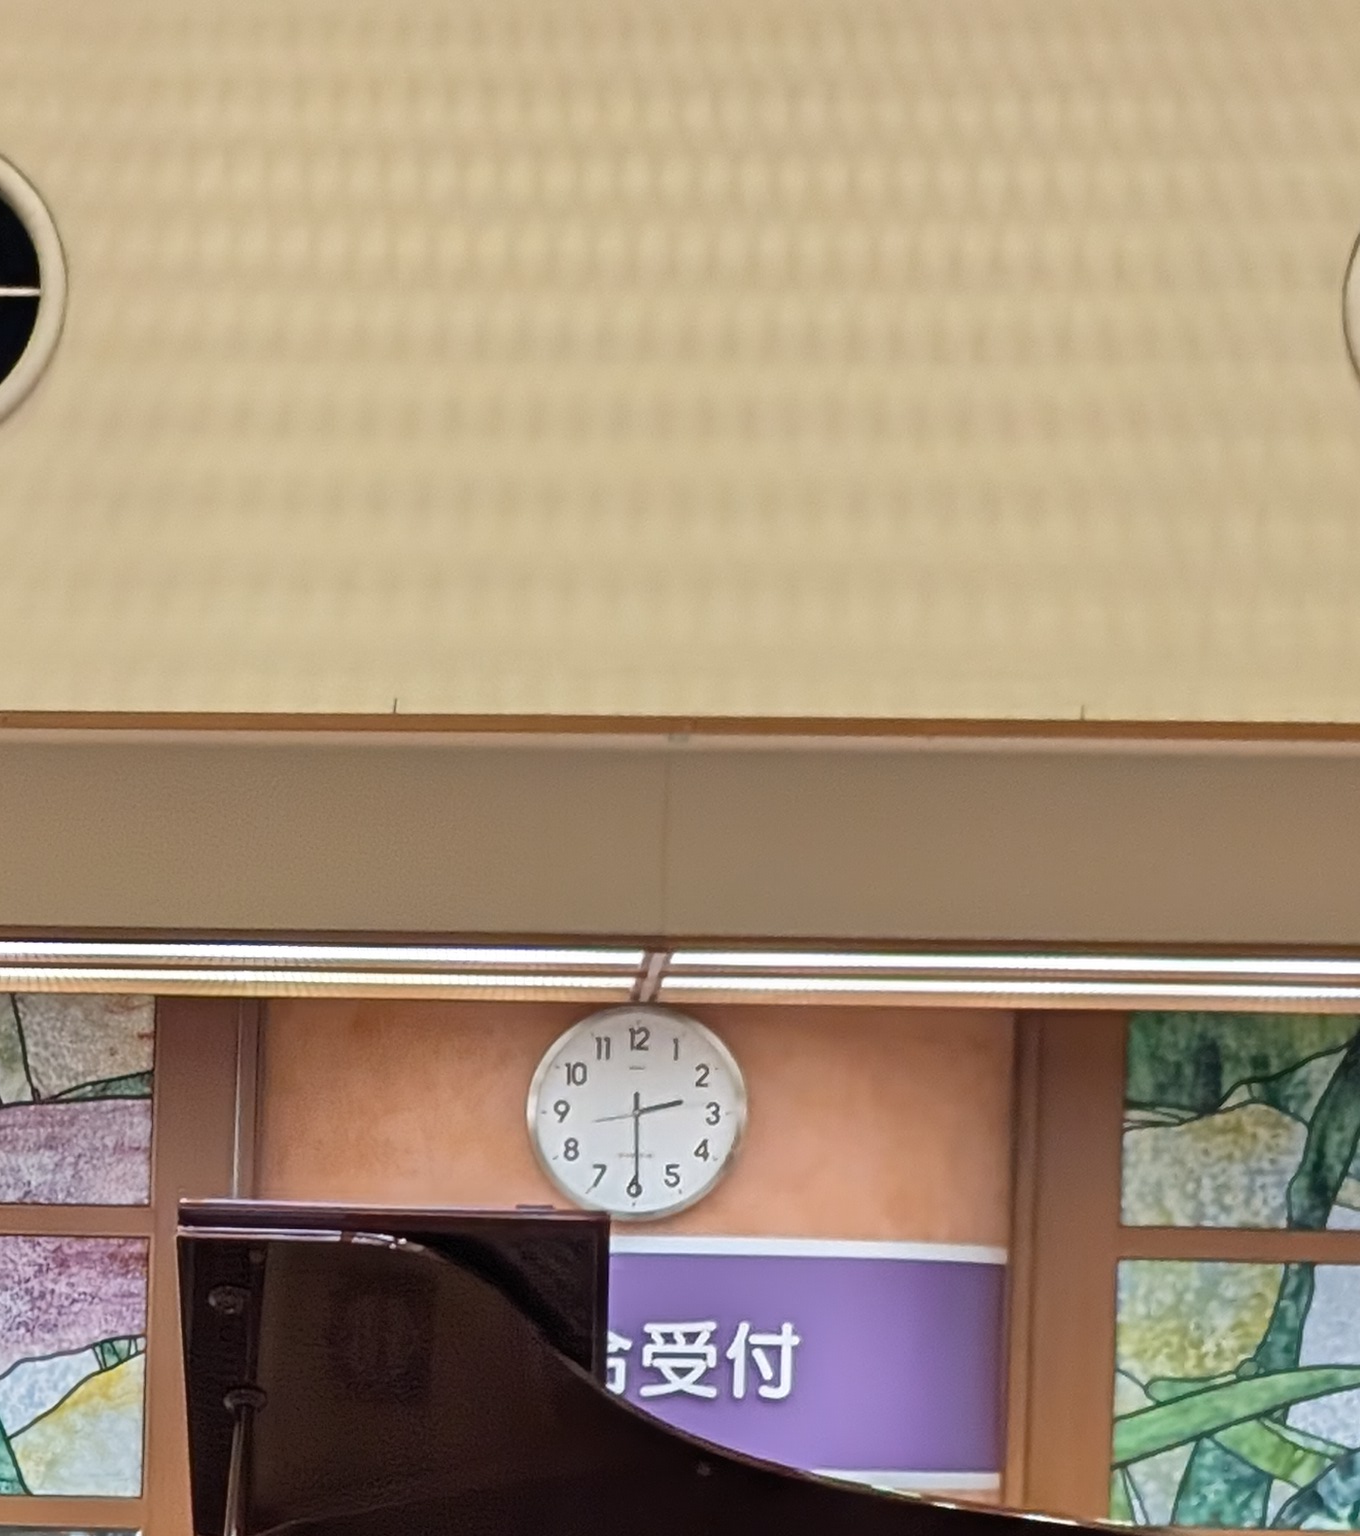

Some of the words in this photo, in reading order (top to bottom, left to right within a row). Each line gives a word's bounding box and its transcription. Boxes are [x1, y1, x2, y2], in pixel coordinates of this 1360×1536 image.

[595, 1036, 611, 1060] 11
[629, 1027, 650, 1051] 12
[672, 1038, 680, 1061] 1
[565, 1062, 588, 1086] 10
[695, 1063, 710, 1087] 2
[553, 1100, 570, 1123] 9
[705, 1102, 721, 1125] 3
[563, 1138, 579, 1161] 8
[694, 1139, 710, 1162] 4
[593, 1164, 607, 1188] 7
[626, 1175, 643, 1198] 6
[664, 1164, 681, 1188] 5
